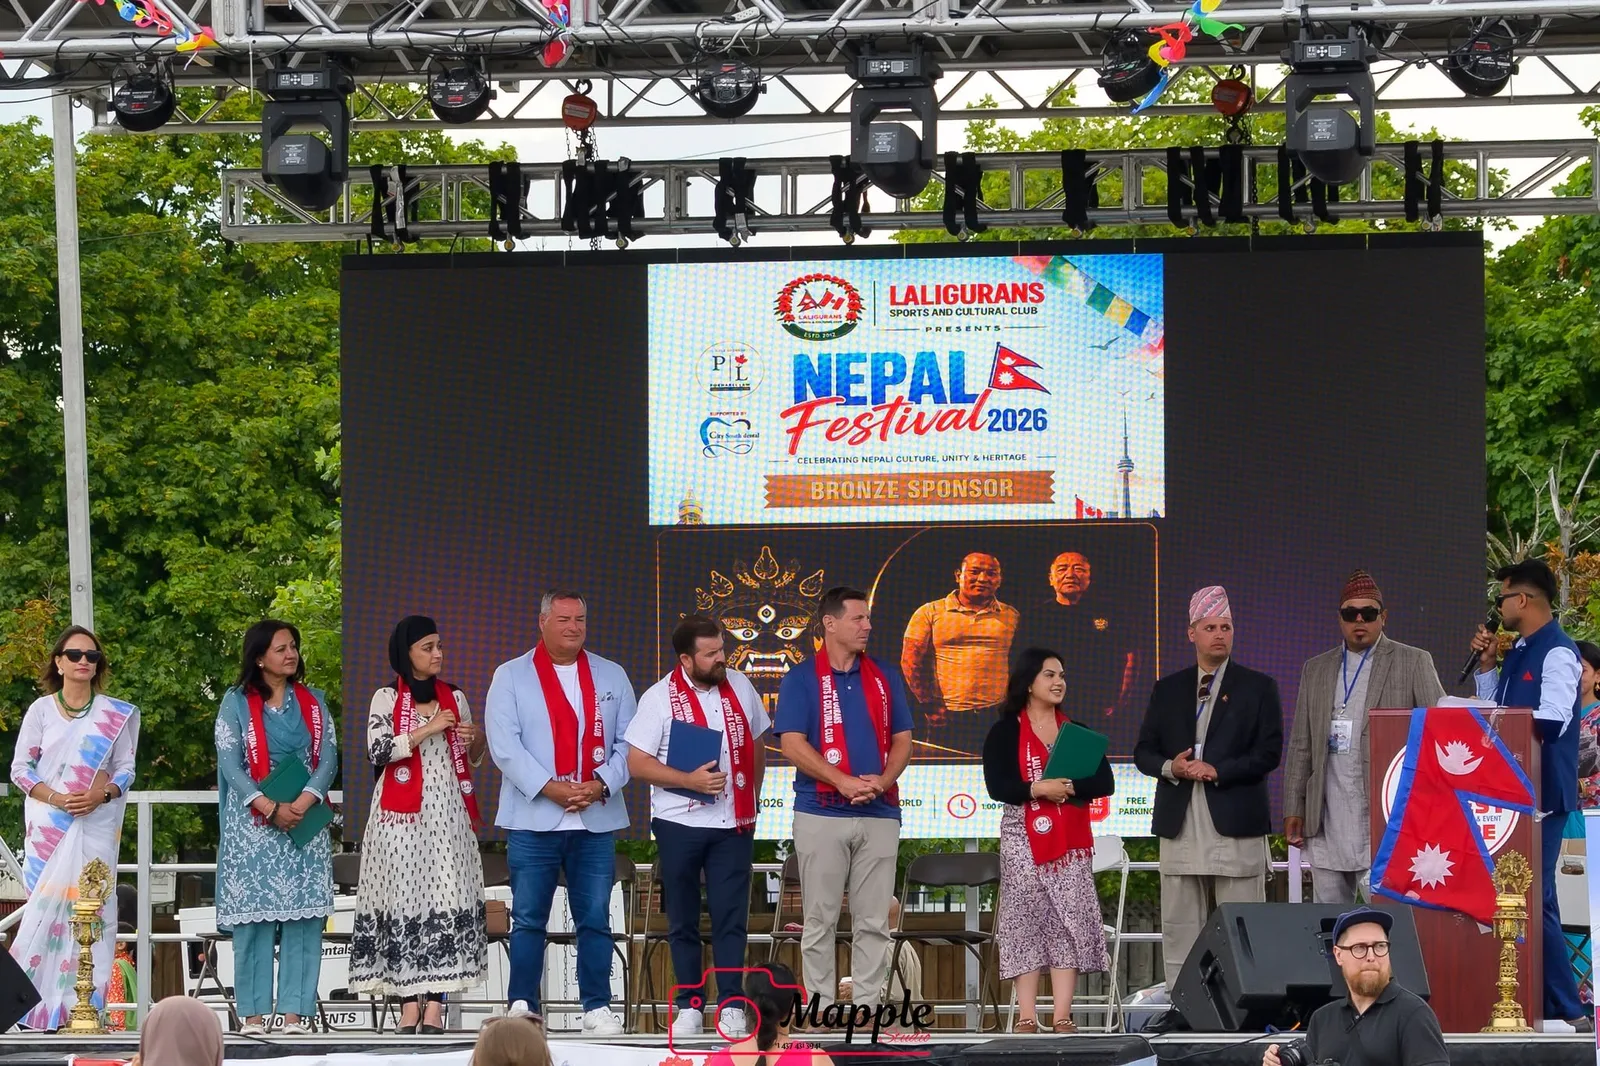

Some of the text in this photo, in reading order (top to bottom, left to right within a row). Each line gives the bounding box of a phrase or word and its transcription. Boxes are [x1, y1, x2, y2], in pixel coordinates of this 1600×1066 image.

[890, 282, 1045, 306] LALIGURANS
[890, 309, 929, 317] SPORTS
[955, 307, 1008, 316] CULTURAL
[1011, 307, 1038, 315] CLUB
[712, 356, 725, 371] P
[735, 366, 748, 381] L
[794, 350, 979, 405] NEPAL
[780, 388, 1048, 455] Festival 2026
[811, 478, 1014, 500] BRONZE SPONSOR
[822, 675, 832, 695] SPORTS
[402, 692, 411, 710] SPORTS
[734, 712, 743, 724] LALI
[823, 699, 833, 728] CULTURAL
[594, 721, 602, 737] CLUB
[721, 697, 734, 717] SPORTS
[728, 721, 739, 750] CULTURAL
[825, 728, 834, 743] CLUB
[455, 760, 465, 774] CLUB
[1031, 756, 1042, 769] LALI
[321, 944, 354, 956] entals
